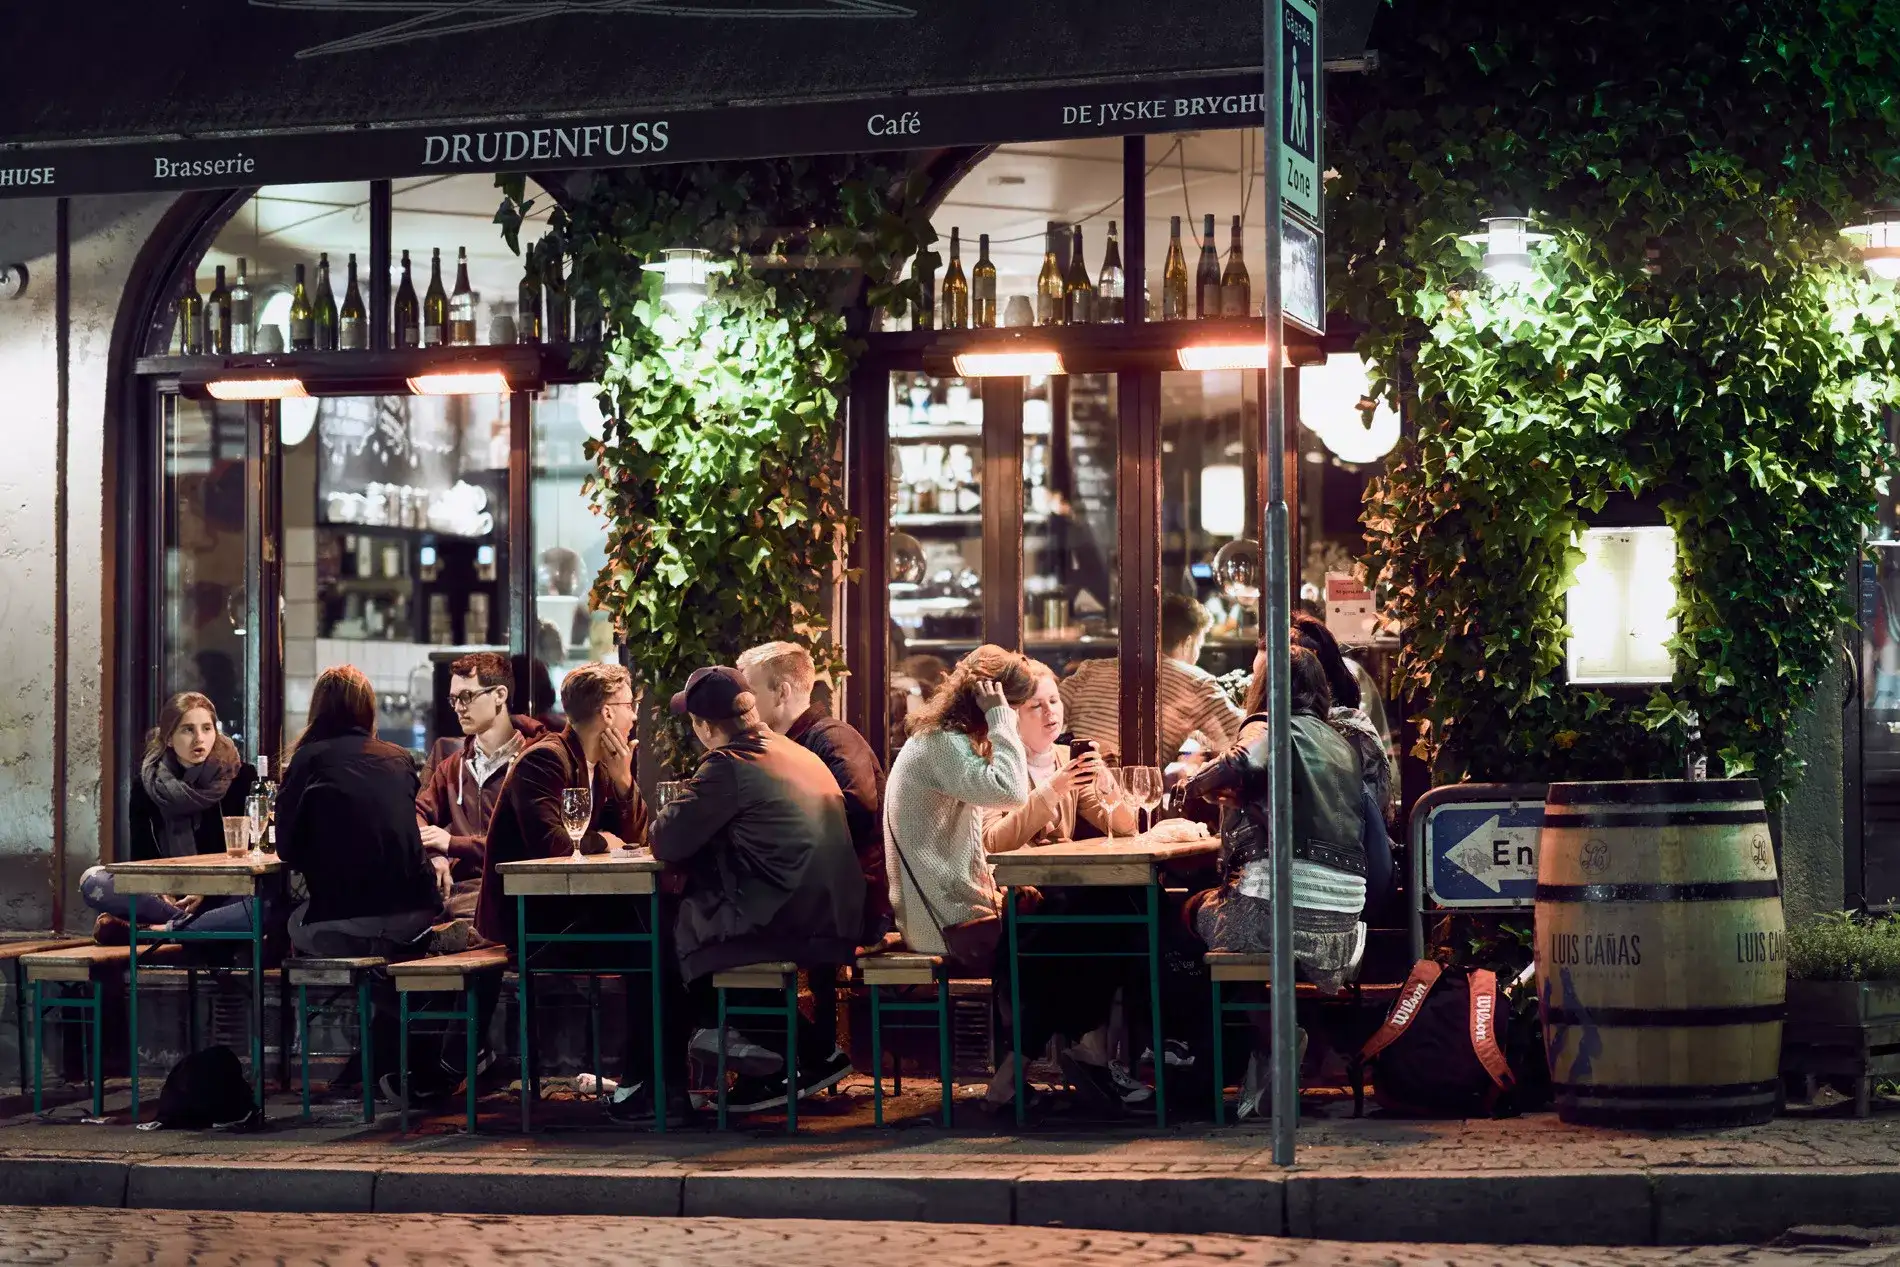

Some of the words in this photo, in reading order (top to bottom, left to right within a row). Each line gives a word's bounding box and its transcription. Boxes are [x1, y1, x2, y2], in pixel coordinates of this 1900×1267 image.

[867, 111, 921, 136] Café
[1062, 105, 1092, 125] DE
[1097, 100, 1166, 126] JYSKE
[421, 121, 669, 165] DRUDENFUSS
[0, 167, 55, 186] HUSE
[154, 152, 255, 178] Brasserie
[1287, 157, 1311, 198] Zone
[1493, 840, 1533, 866] En
[1552, 933, 1580, 964] LUIS
[1585, 933, 1641, 966] CAÑAS
[1737, 932, 1767, 964] LUIS
[1391, 983, 1428, 1026] Wilson
[1475, 995, 1492, 1042] Wilson
